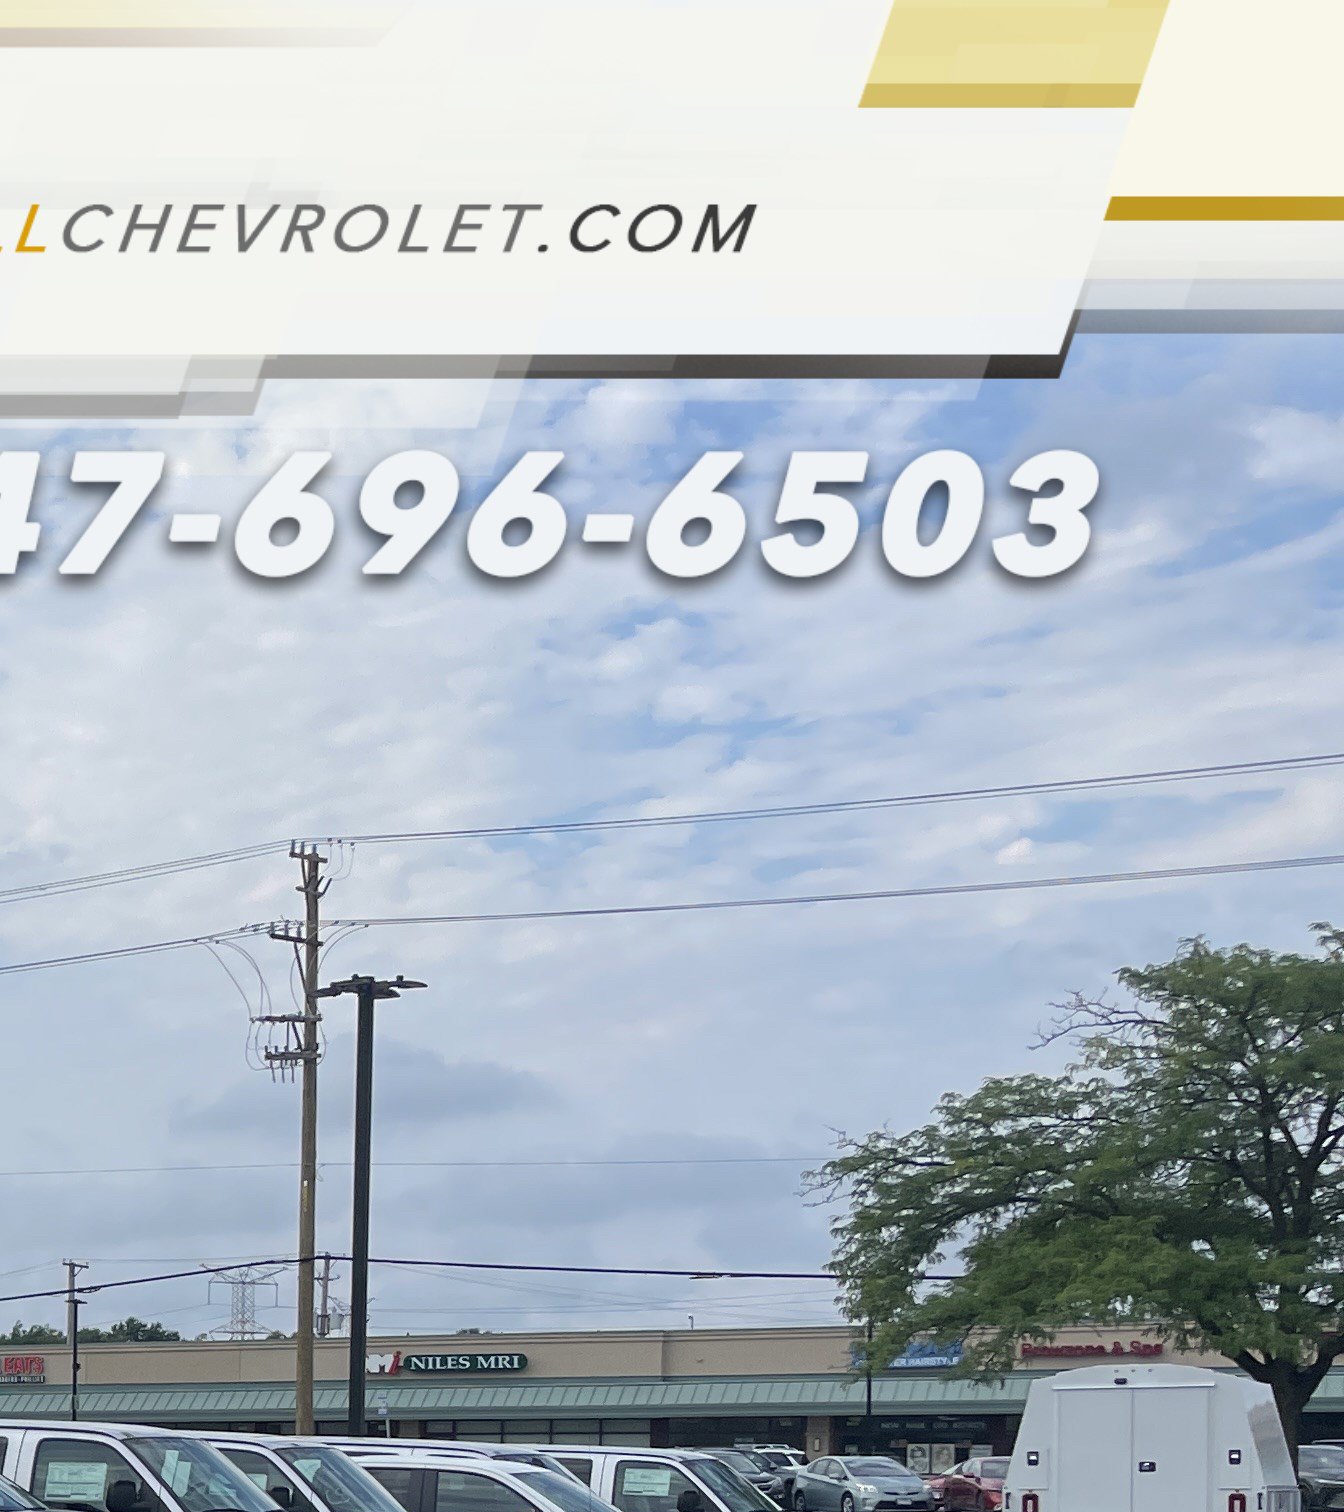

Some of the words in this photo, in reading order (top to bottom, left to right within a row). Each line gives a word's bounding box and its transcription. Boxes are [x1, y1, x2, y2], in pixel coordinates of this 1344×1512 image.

[4, 1356, 44, 1375] EATS
[410, 1355, 471, 1370] NILES
[476, 1355, 520, 1369] MRI
